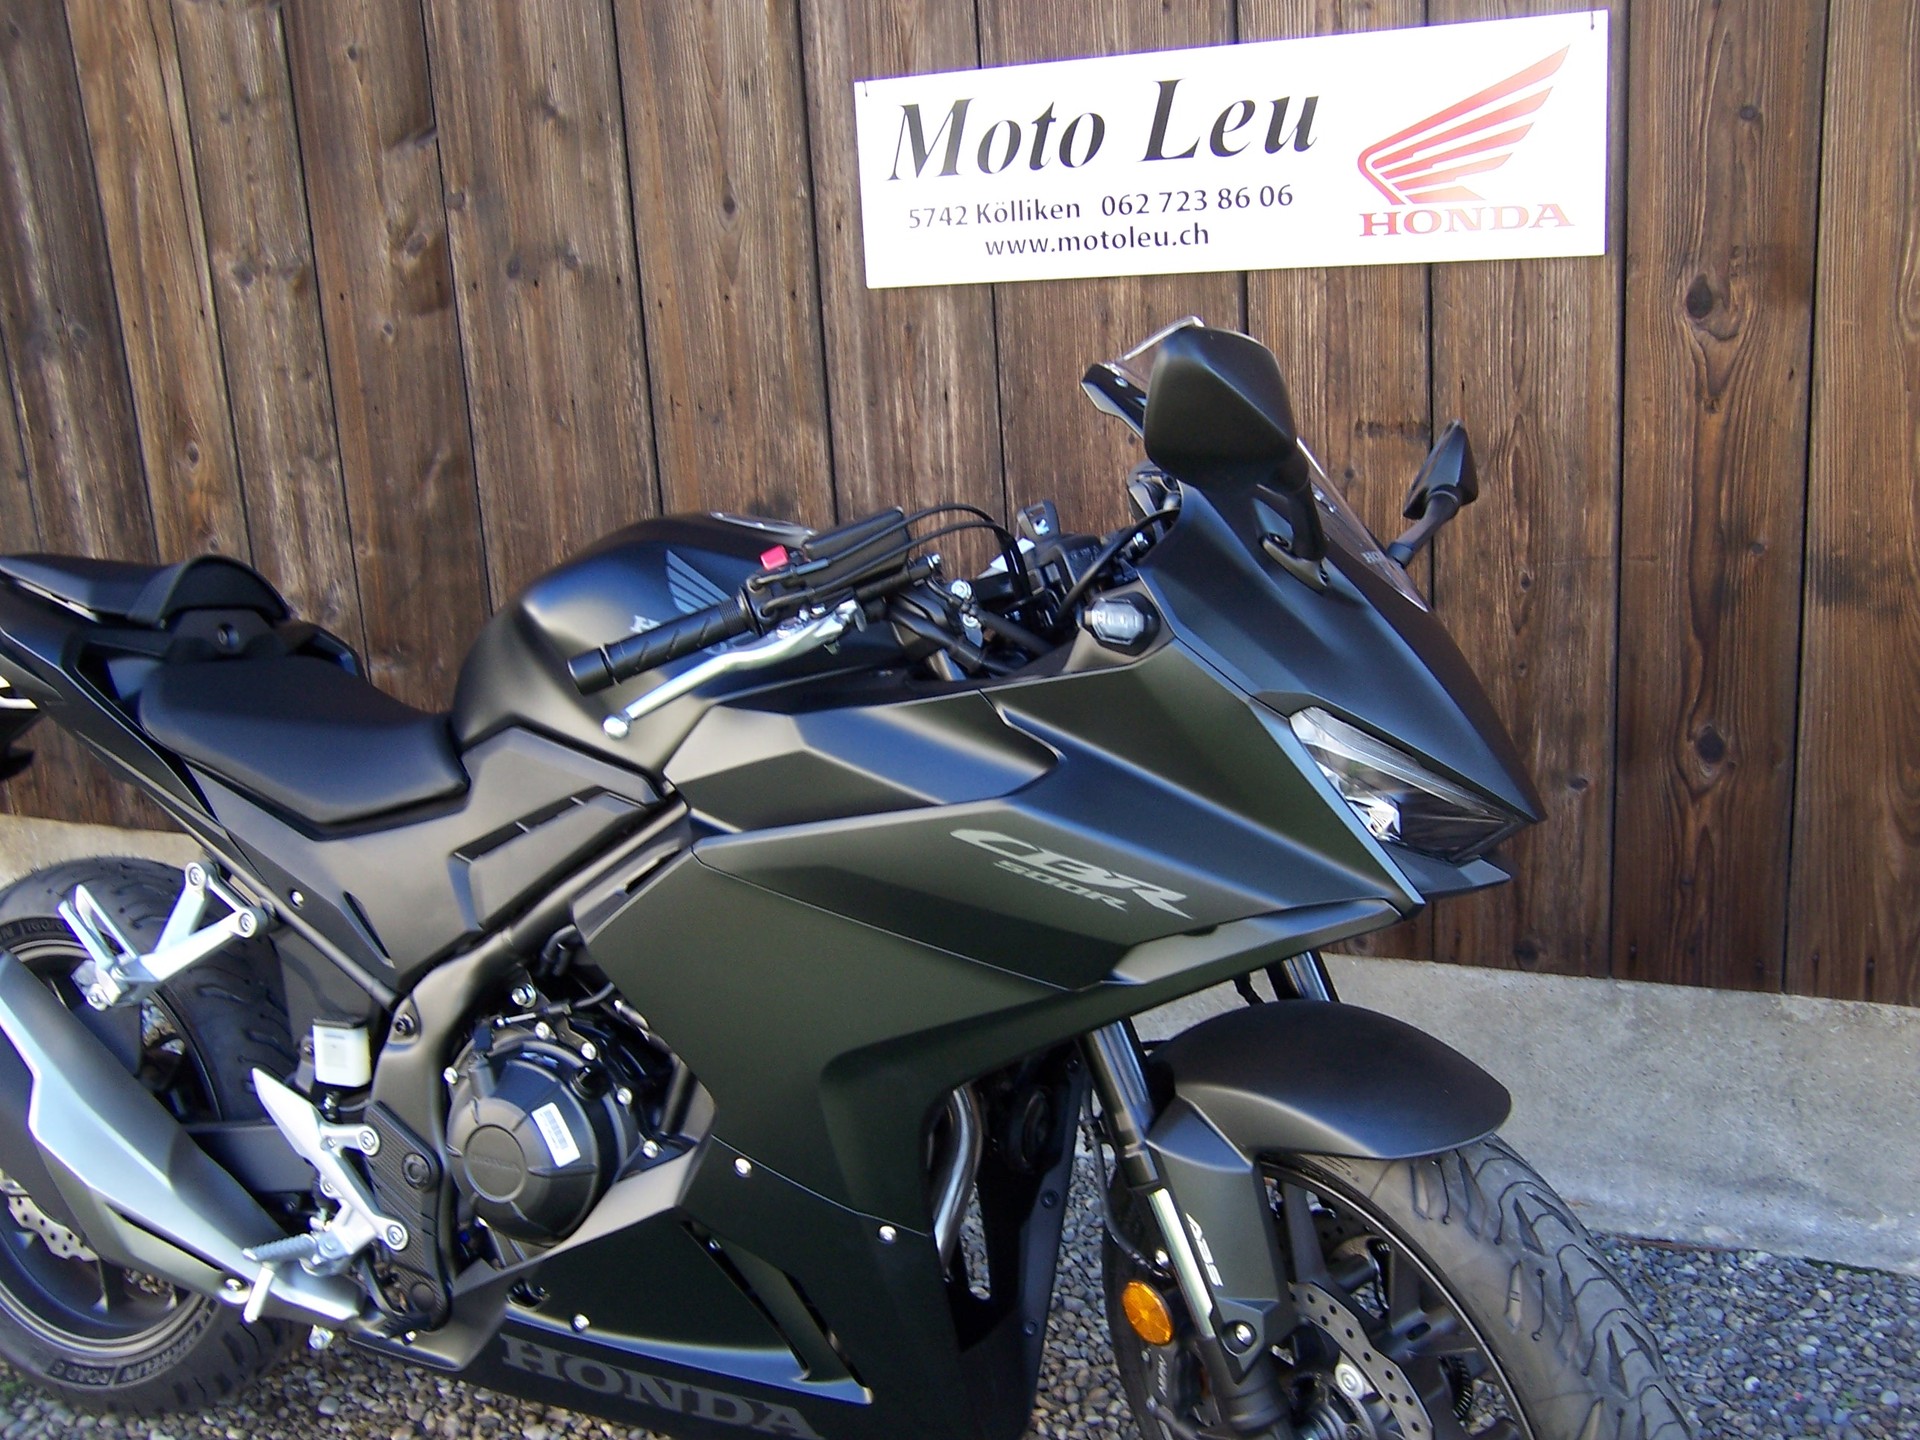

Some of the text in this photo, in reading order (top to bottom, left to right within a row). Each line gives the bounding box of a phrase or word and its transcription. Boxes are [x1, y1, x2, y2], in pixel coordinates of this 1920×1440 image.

[887, 78, 1321, 182] Moto Leu
[908, 183, 1294, 230] 5742 Kölliken 062 723 86 06
[1358, 203, 1576, 237] HONDA
[984, 221, 1210, 256] www.motoleu.ch
[950, 828, 1194, 920] CBR
[993, 859, 1129, 914] 500R
[500, 1333, 824, 1439] HONDA
